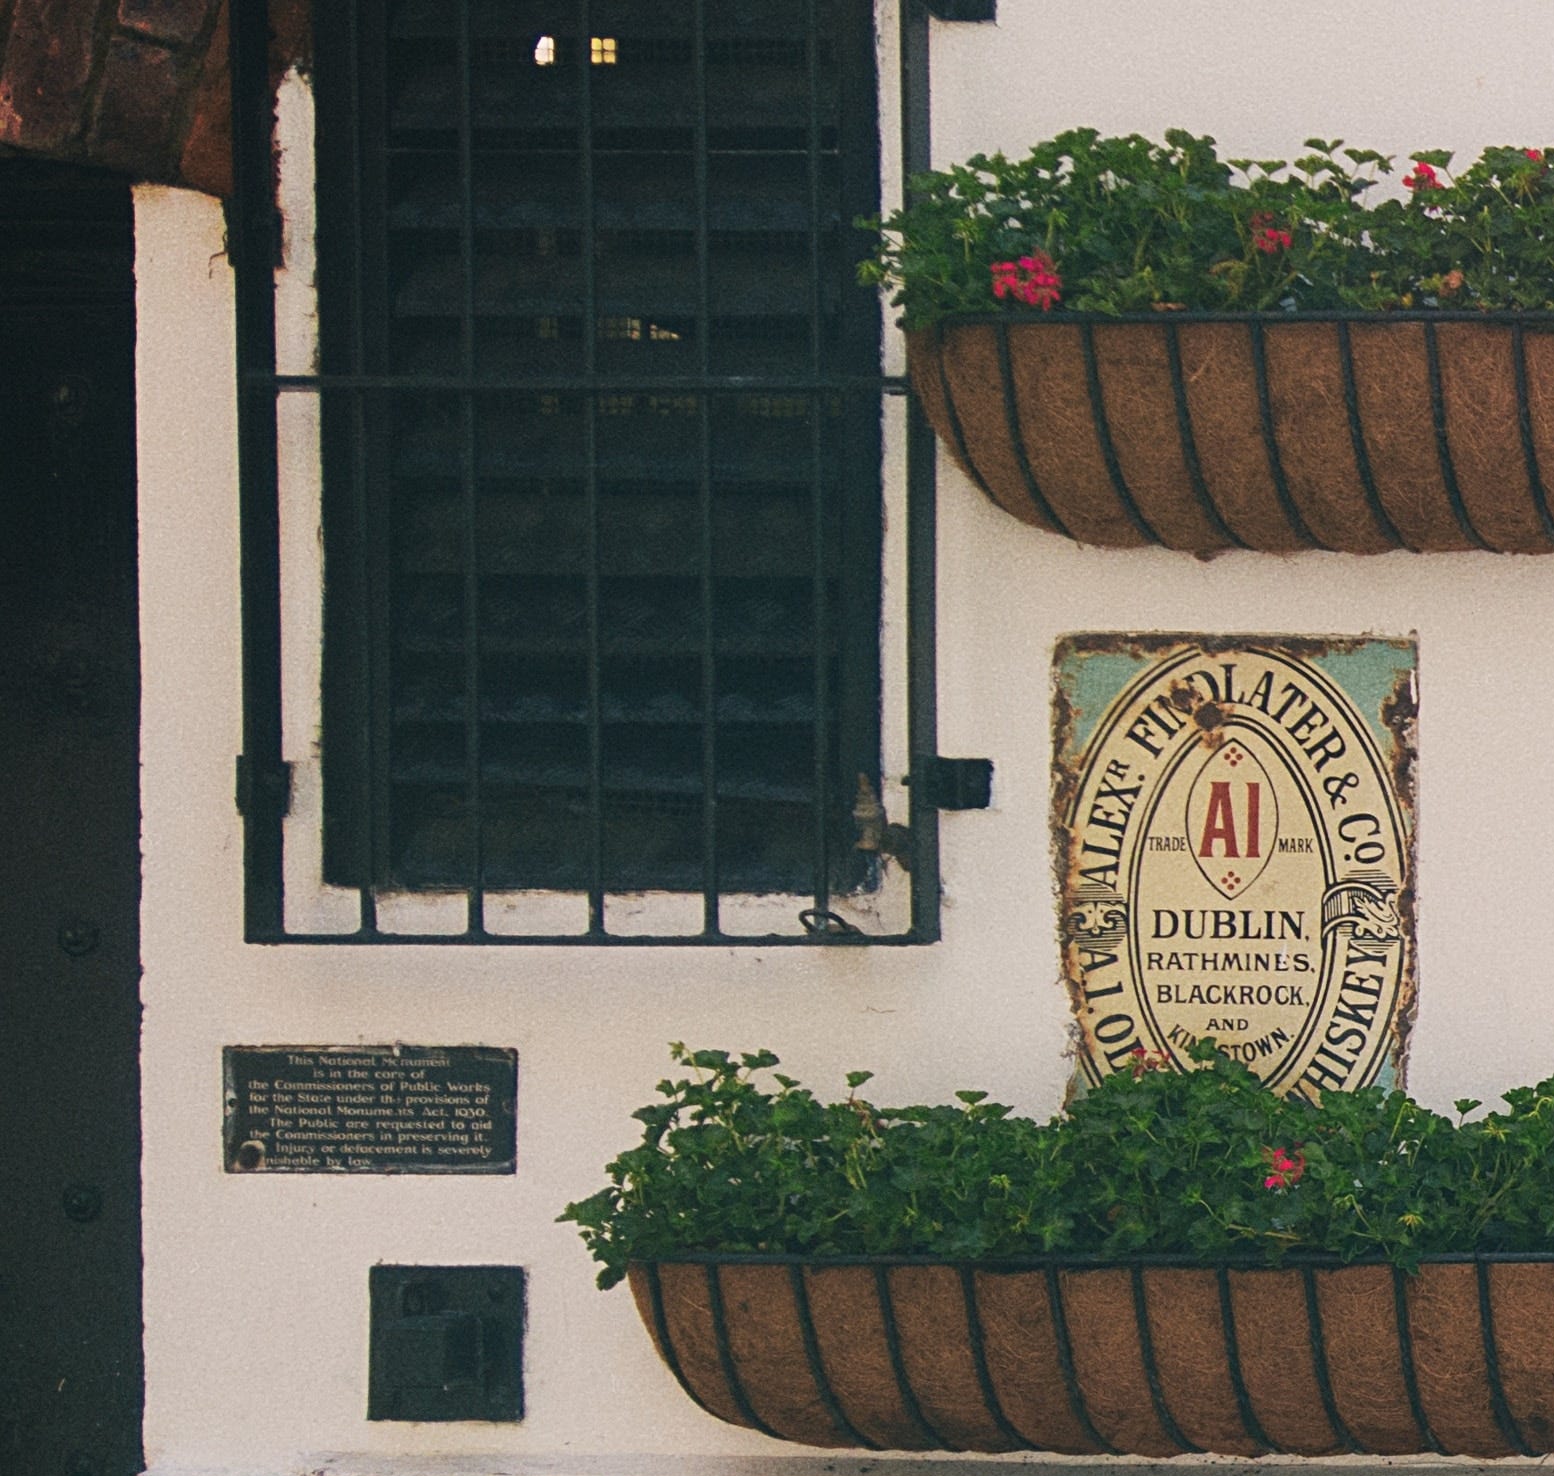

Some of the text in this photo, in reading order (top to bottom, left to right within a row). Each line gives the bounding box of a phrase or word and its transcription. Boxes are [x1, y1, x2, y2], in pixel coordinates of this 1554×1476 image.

[1124, 663, 1347, 773] FINDLATER
[1323, 772, 1360, 810] &
[1148, 836, 1314, 854] TRADE MARK
[1206, 1018, 1249, 1031] AND
[1283, 940, 1387, 1109] HISKEY
[1167, 1023, 1296, 1063] KINSTOWN.
[287, 1054, 314, 1066] This
[319, 1055, 376, 1067] National
[329, 1068, 342, 1079] in
[347, 1068, 369, 1079] the
[374, 1070, 406, 1080] care
[410, 1068, 426, 1080] of
[248, 1079, 491, 1093] the Commissioners of Public Works
[249, 1091, 491, 1107] for the State under th provisions of
[248, 1104, 269, 1115] the
[274, 1104, 332, 1116] National
[270, 1117, 493, 1132] The Public are requested to aid
[249, 1128, 270, 1139] the
[275, 1129, 375, 1141] Commissioners
[380, 1131, 393, 1142] in
[398, 1131, 470, 1145] preserving
[275, 1141, 493, 1159] Injury or defacement is severely
[264, 1155, 322, 1166] nishable
[326, 1155, 342, 1167] by
